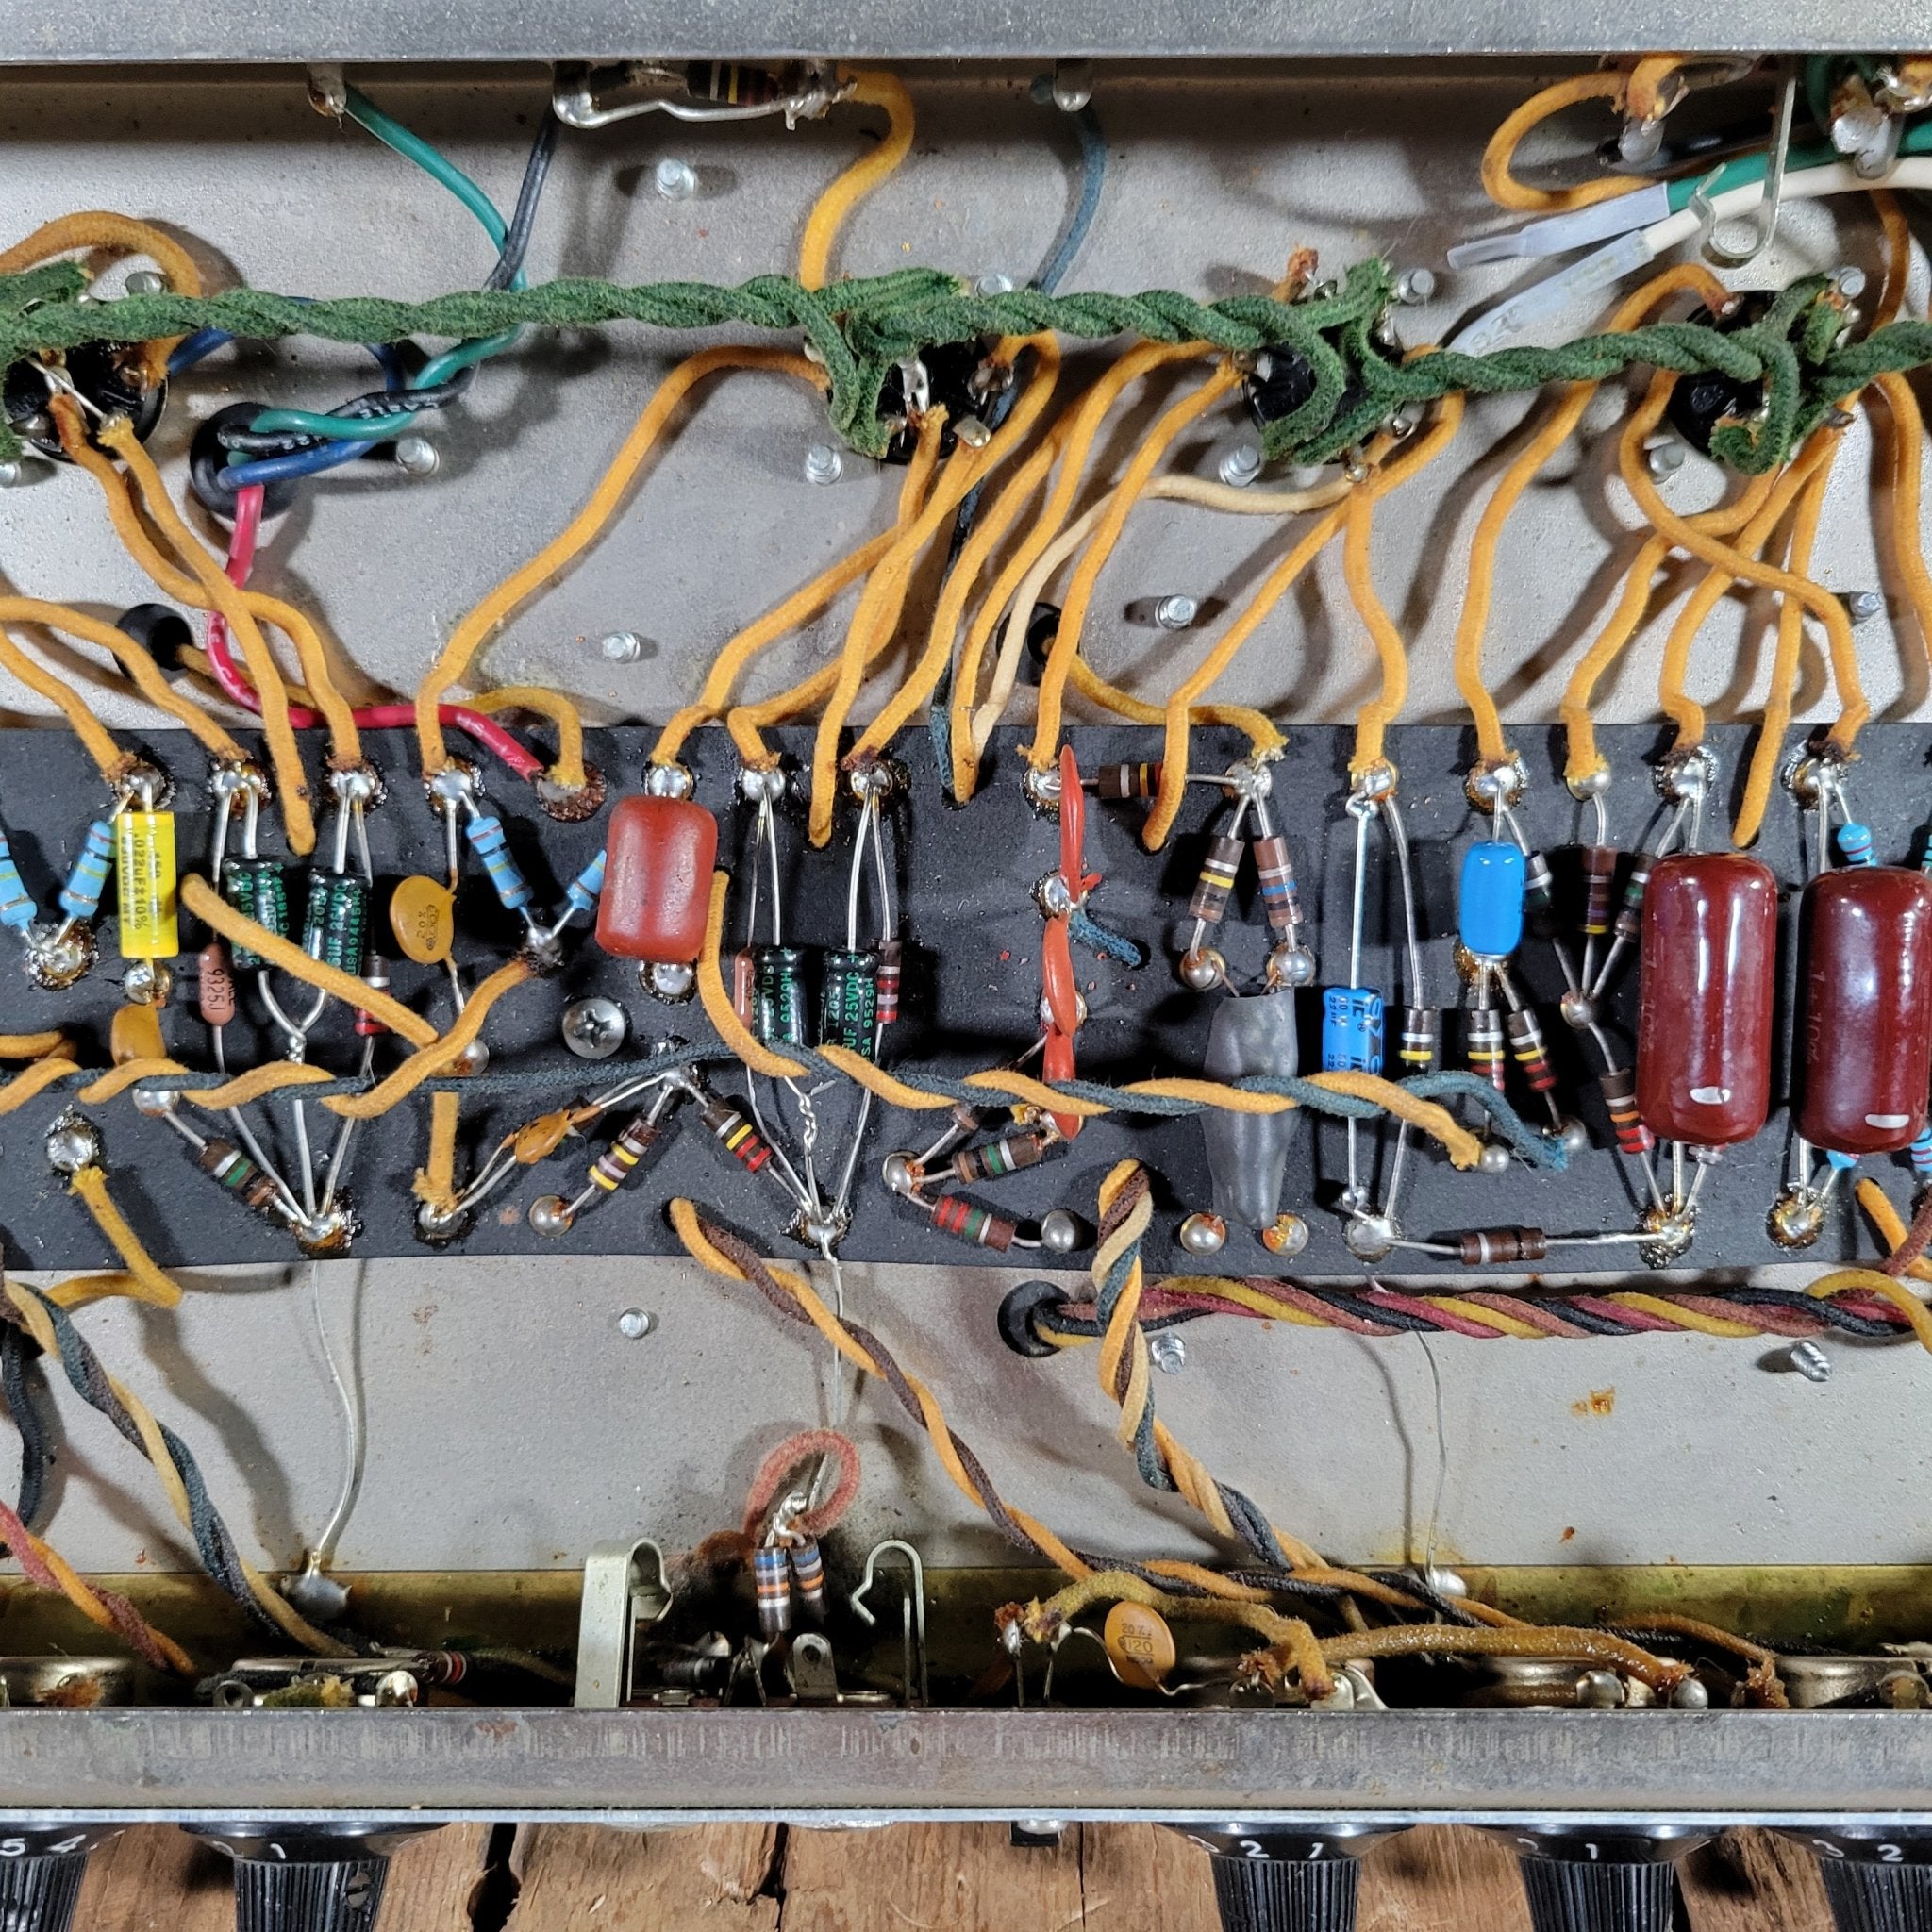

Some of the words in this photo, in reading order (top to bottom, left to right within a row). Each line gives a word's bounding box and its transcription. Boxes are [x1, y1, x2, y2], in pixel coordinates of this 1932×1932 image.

[207, 968, 225, 1010] 9325J
[844, 971, 859, 1023] 25VDC
[862, 977, 874, 1029] 9529H
[0, 1837, 27, 1857] 5
[47, 1833, 87, 1854] 4
[1239, 1840, 1270, 1858] 2
[1308, 1841, 1324, 1859] 1
[1585, 1842, 1599, 1860] 1
[1876, 1843, 1905, 1862] 2
